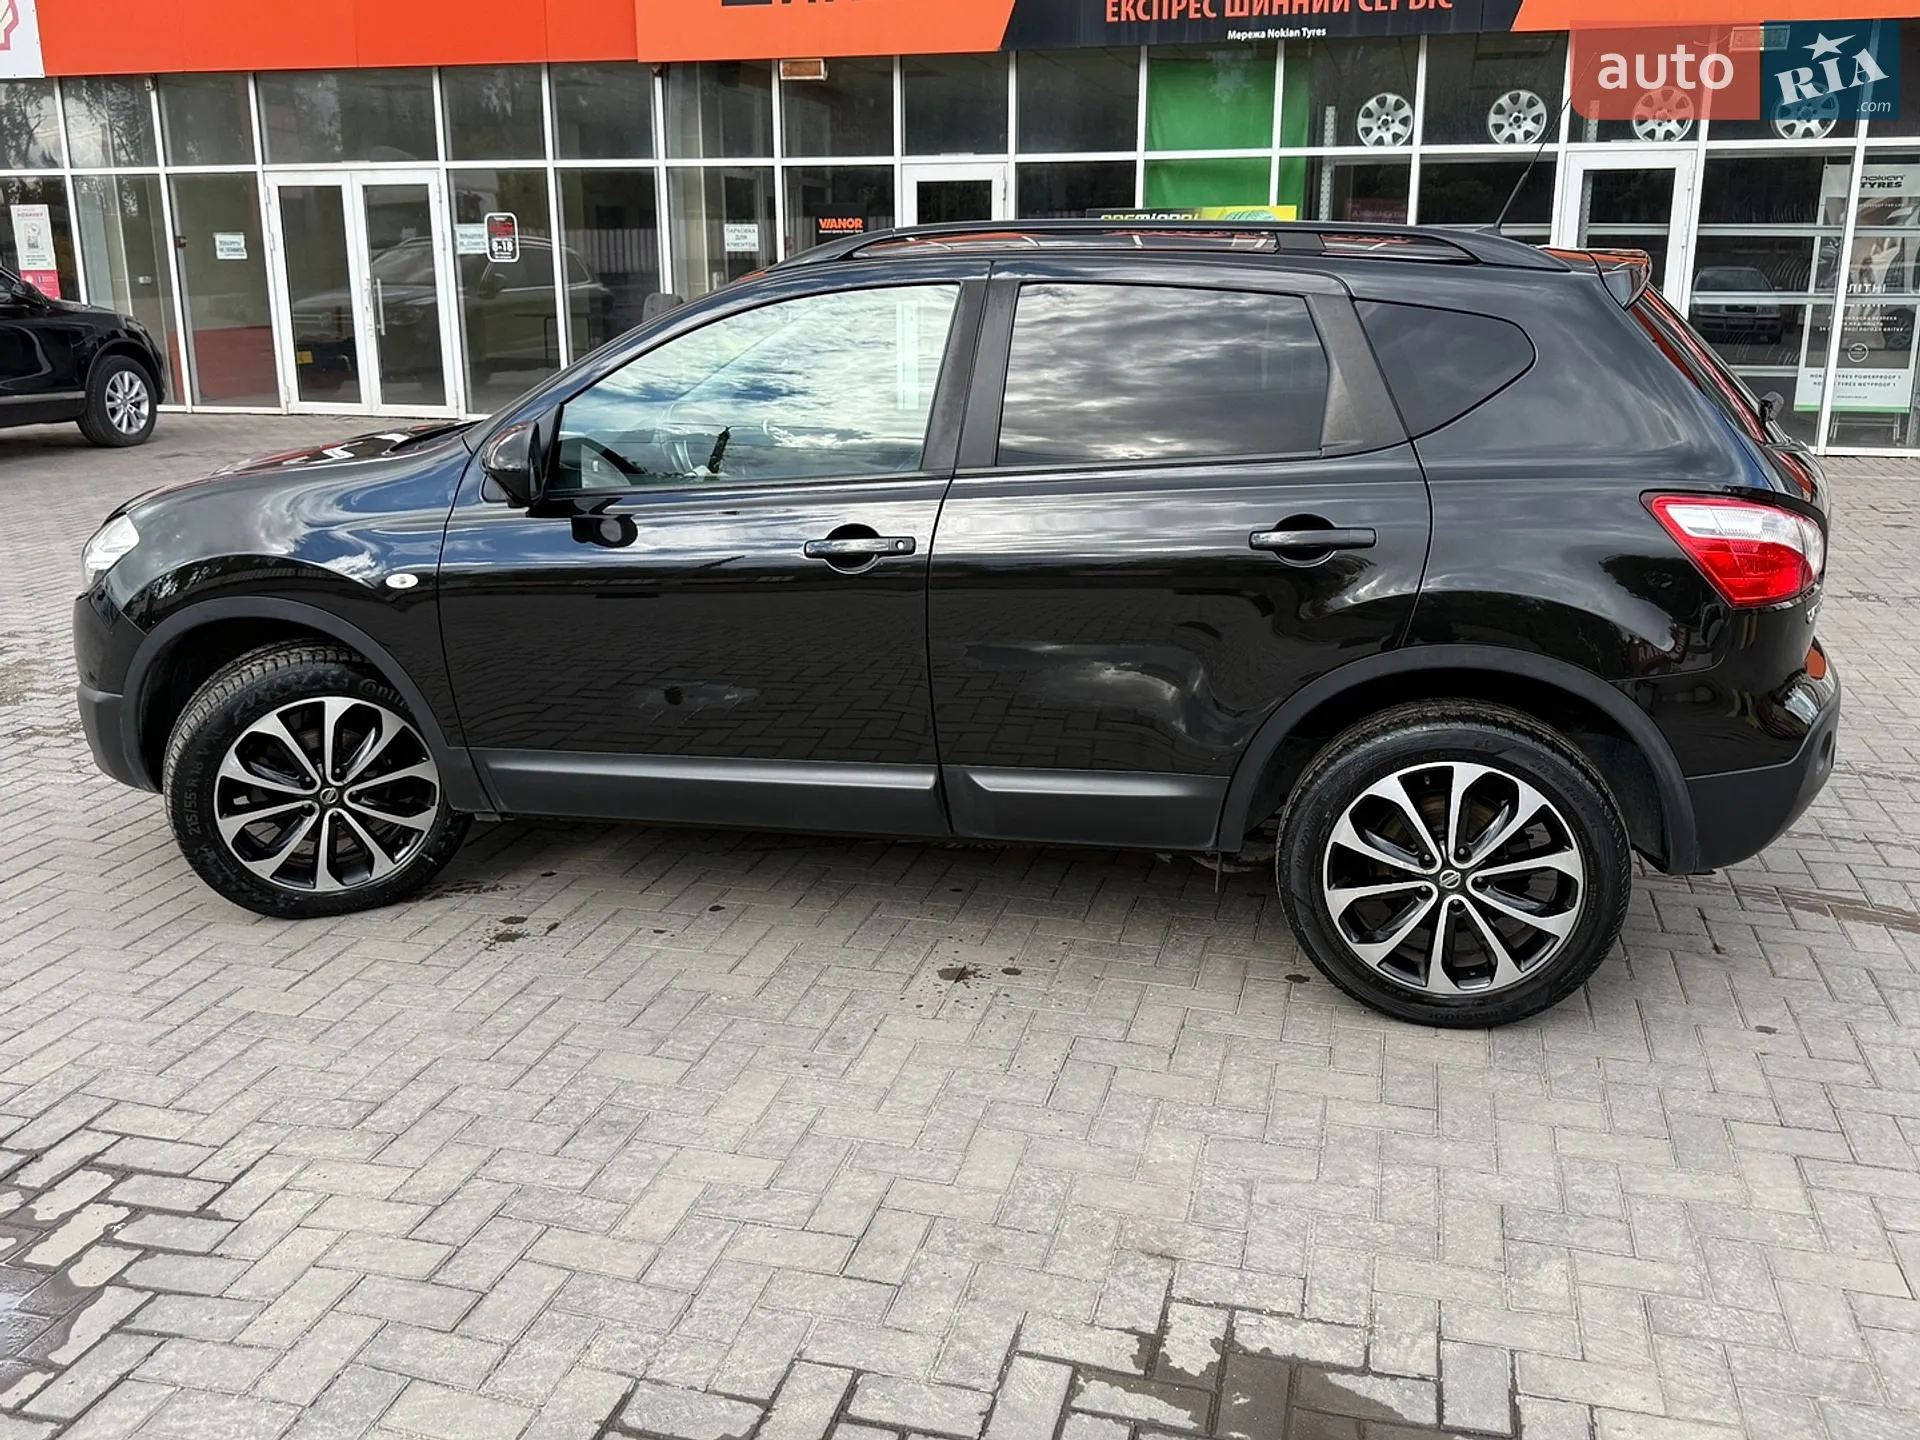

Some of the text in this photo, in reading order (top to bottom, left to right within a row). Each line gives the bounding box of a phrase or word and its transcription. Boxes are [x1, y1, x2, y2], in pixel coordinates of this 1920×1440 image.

[1106, 0, 1217, 22] ЕКСПРЕС
[1226, 27, 1327, 41] Мережа Nokian Tyres
[1860, 181, 1903, 189] TYRES
